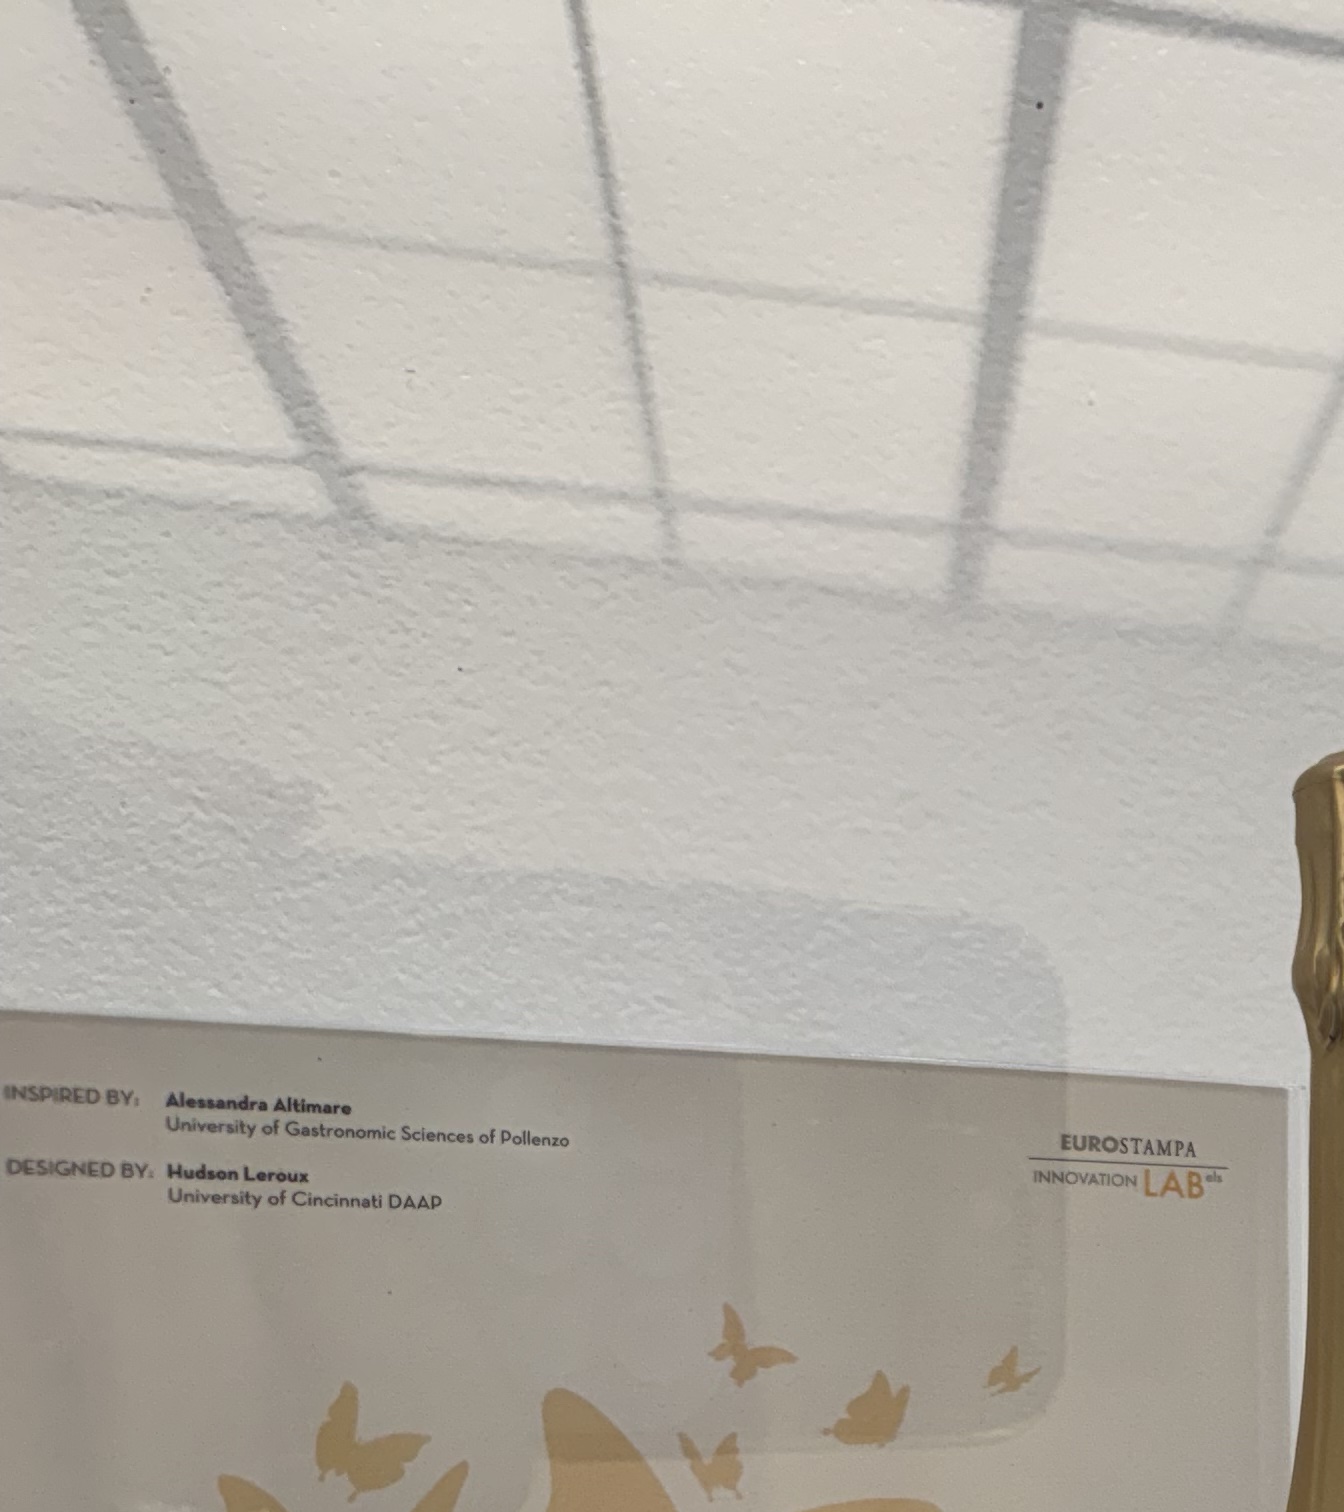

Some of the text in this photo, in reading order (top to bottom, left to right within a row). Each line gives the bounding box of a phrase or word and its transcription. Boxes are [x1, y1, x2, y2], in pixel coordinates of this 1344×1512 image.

[3, 1084, 352, 1115] INSPIRED BY: Alessandra Altimare
[165, 1115, 570, 1148] University of Gastronomic Sciences of Pollenzo
[1060, 1133, 1197, 1158] EUROSTAMPA
[6, 1158, 309, 1183] DESIGNED BY: Hudson Leroux
[1033, 1169, 1137, 1188] INNOVATION
[168, 1188, 442, 1211] University of Cincinnati DAAP
